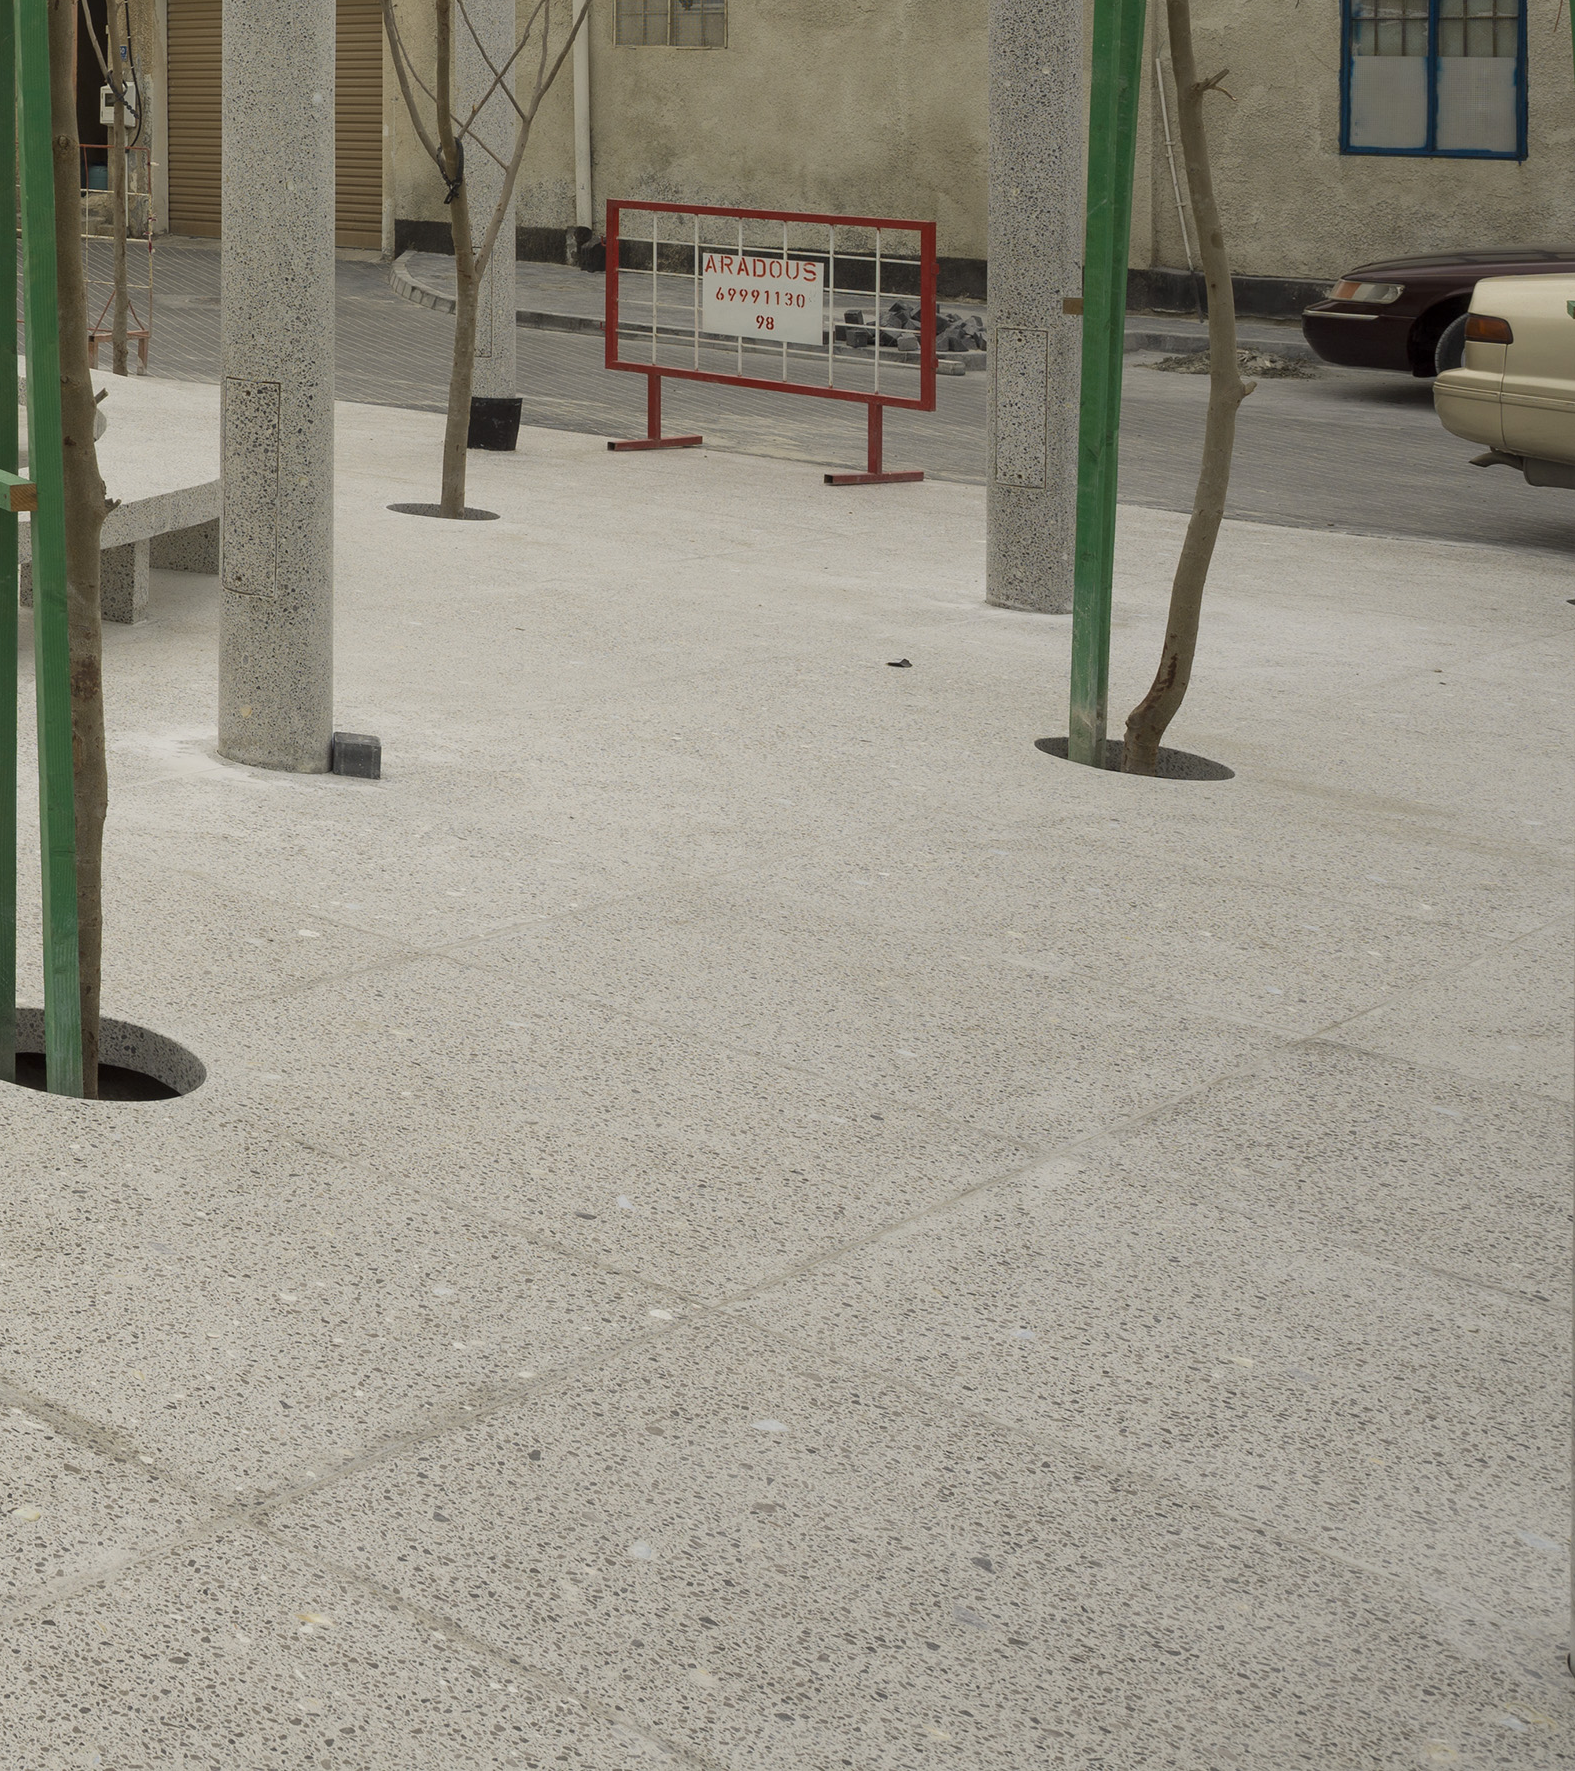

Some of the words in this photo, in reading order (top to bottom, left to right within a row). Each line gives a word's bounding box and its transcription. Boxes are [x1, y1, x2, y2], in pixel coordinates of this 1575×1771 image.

[704, 255, 817, 282] ARADOUS
[715, 286, 805, 308] 69991130
[756, 315, 774, 330] 98
